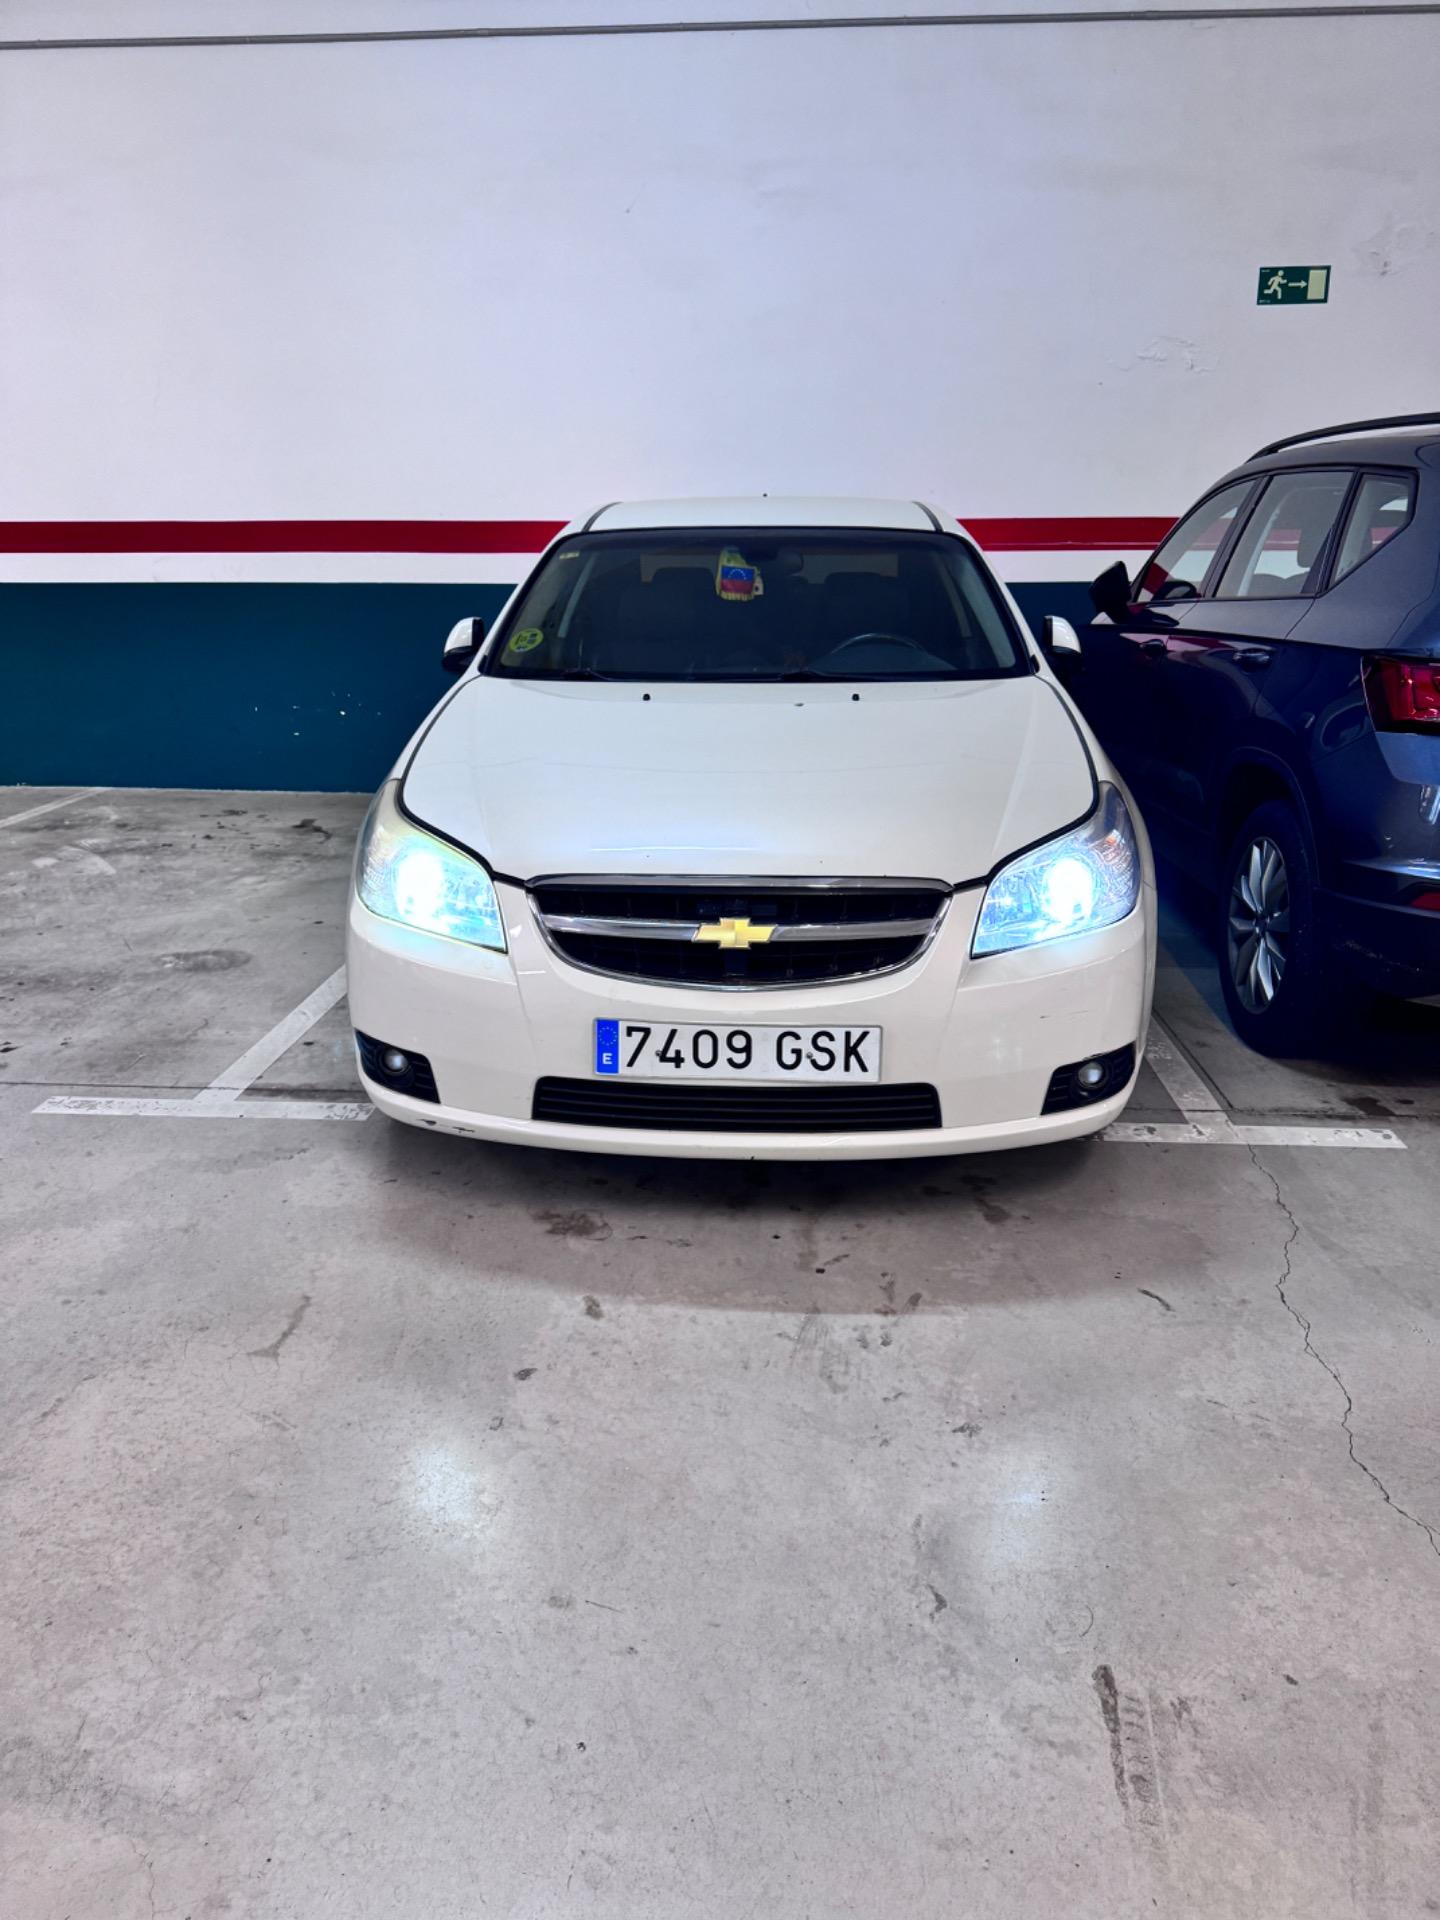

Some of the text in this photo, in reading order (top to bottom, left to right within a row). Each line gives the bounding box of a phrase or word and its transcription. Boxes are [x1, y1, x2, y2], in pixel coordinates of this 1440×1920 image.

[602, 1053, 613, 1065] E
[625, 1026, 870, 1073] 7409 GSK
